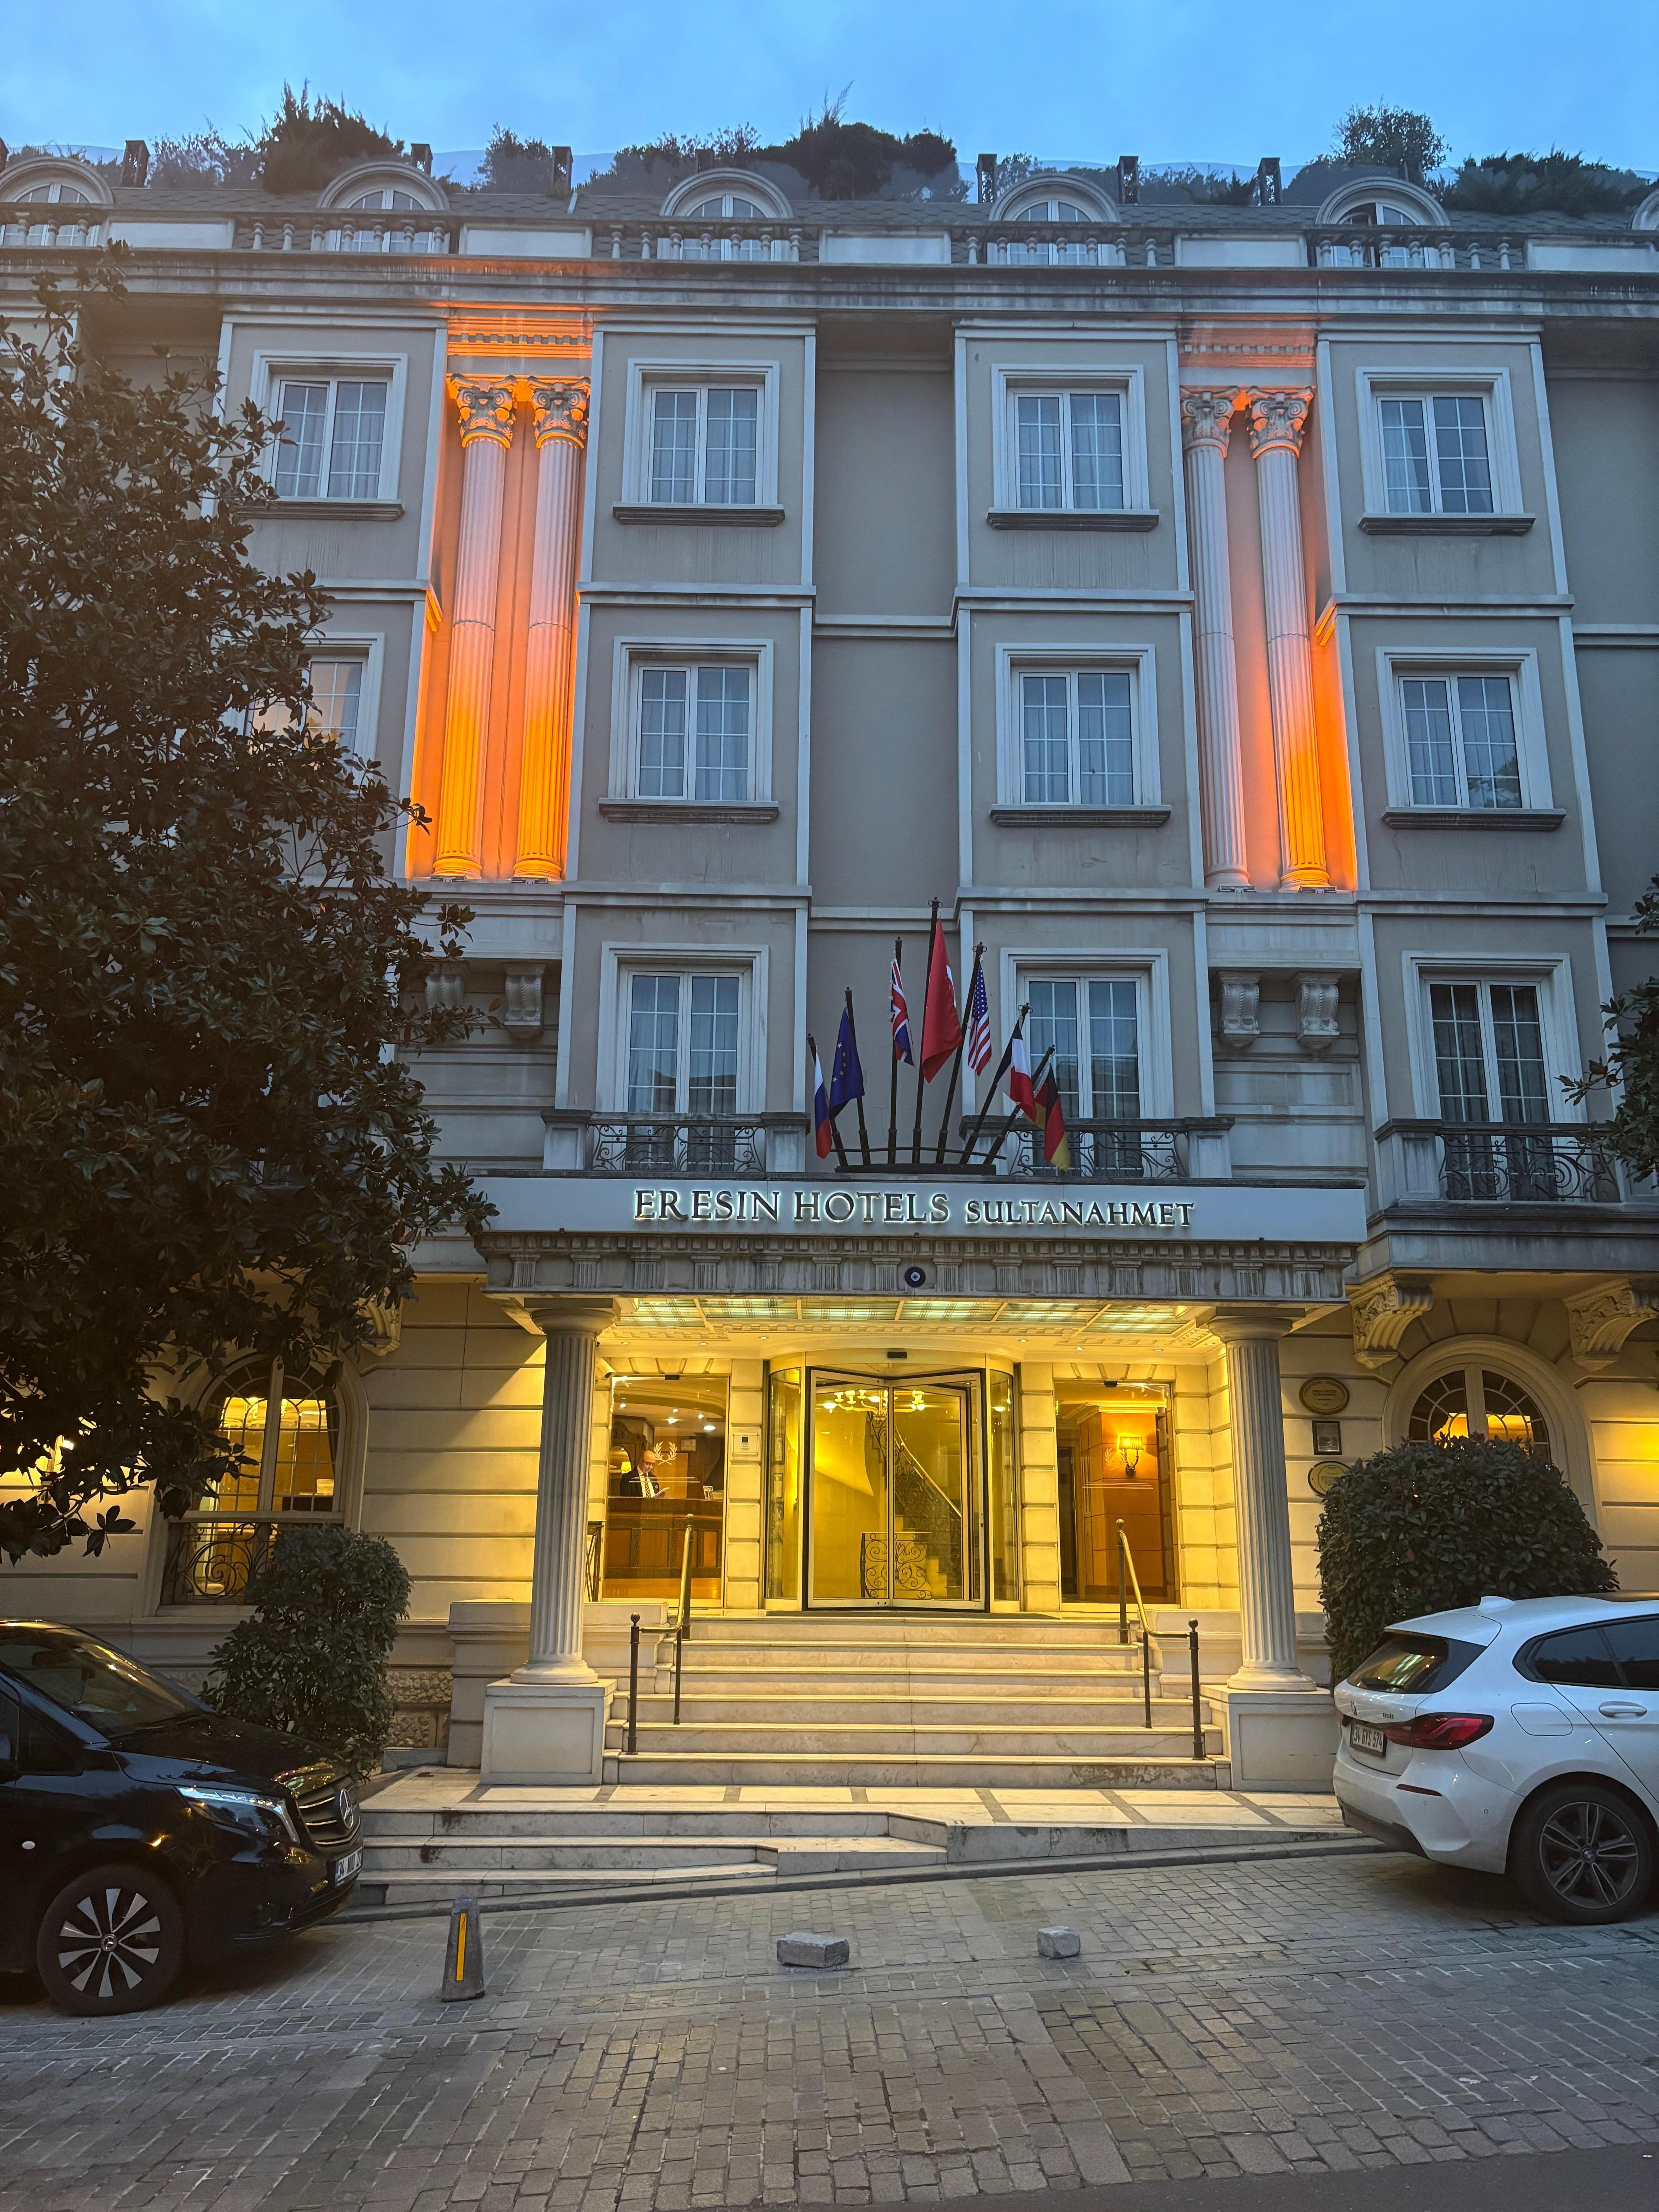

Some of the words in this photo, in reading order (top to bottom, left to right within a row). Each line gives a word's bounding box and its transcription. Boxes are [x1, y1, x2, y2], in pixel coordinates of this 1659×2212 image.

[635, 1190, 780, 1221] ERESIN
[794, 1192, 949, 1223] HOTELS
[967, 1200, 1194, 1226] SULTANAHMET
[1354, 1726, 1360, 1743] 34
[1373, 1731, 1382, 1749] 574
[338, 1859, 344, 1879] 34
